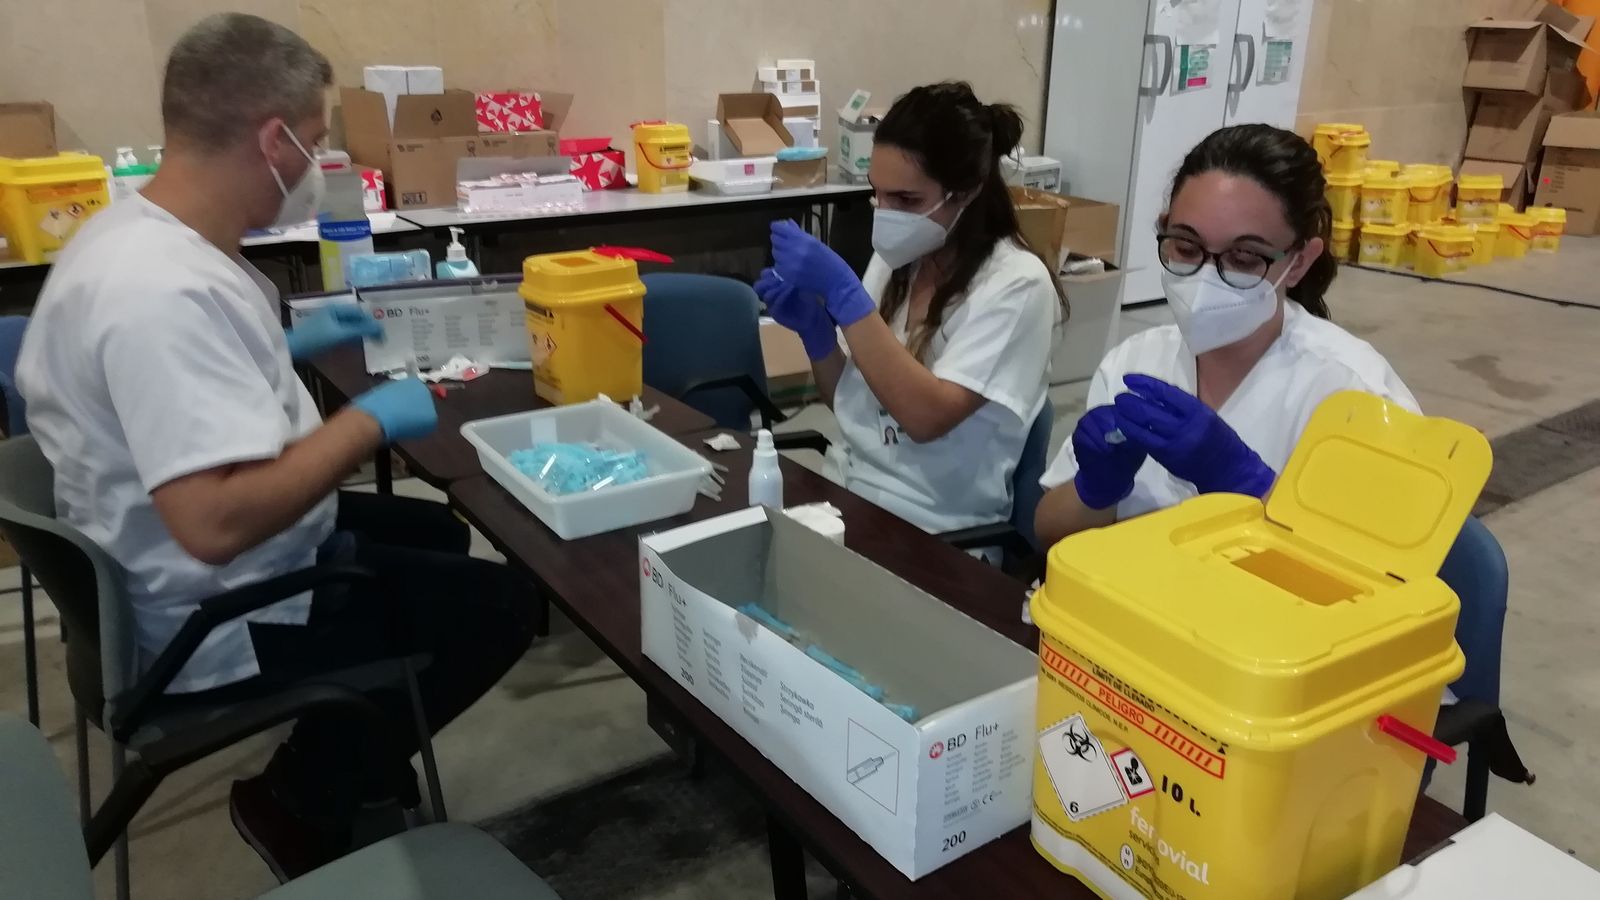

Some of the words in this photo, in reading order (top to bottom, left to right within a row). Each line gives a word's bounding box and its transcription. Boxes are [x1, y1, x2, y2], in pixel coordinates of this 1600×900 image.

[387, 308, 403, 318] BD
[652, 566, 664, 589] BD
[668, 583, 687, 608] Flu+
[680, 666, 695, 686] 200
[1098, 686, 1145, 725] PELIGRO
[947, 733, 967, 752] BD
[975, 722, 1000, 740] Flu+
[1162, 774, 1184, 804] 10
[1069, 801, 1080, 814] 6
[942, 830, 967, 852] 200
[1130, 805, 1210, 887] ferovial
